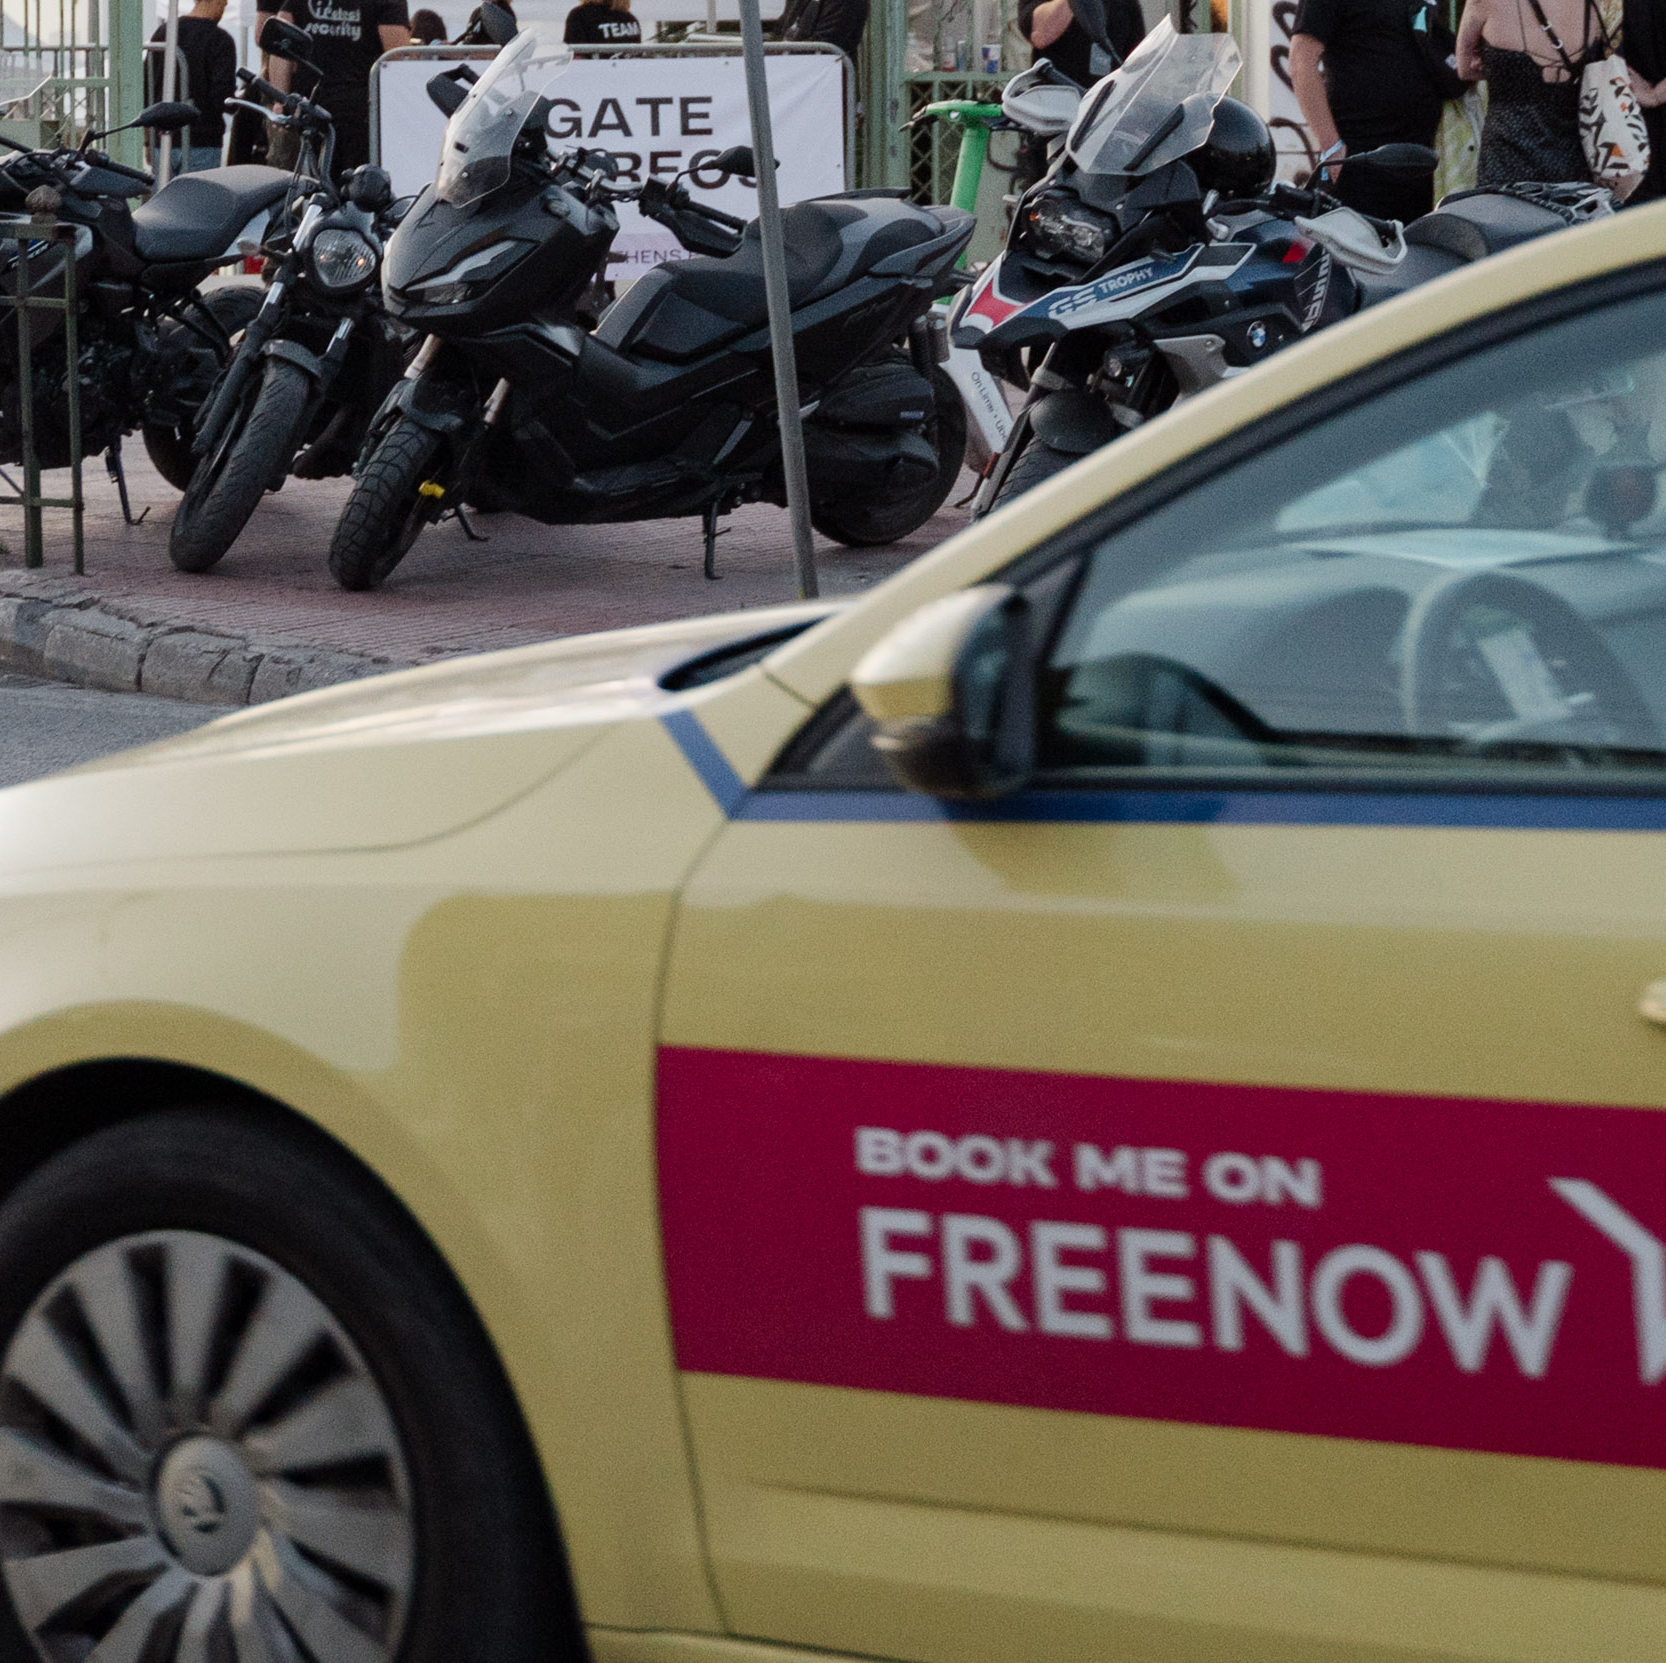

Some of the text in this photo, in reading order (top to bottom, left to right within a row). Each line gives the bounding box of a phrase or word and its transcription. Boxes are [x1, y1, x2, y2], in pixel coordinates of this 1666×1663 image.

[597, 22, 641, 39] TEAM
[544, 96, 714, 140] GATE
[1047, 266, 1154, 319] GS TROPHY
[854, 1126, 1323, 1210] BOOK ME ON
[857, 1205, 1574, 1381] FREENOW
